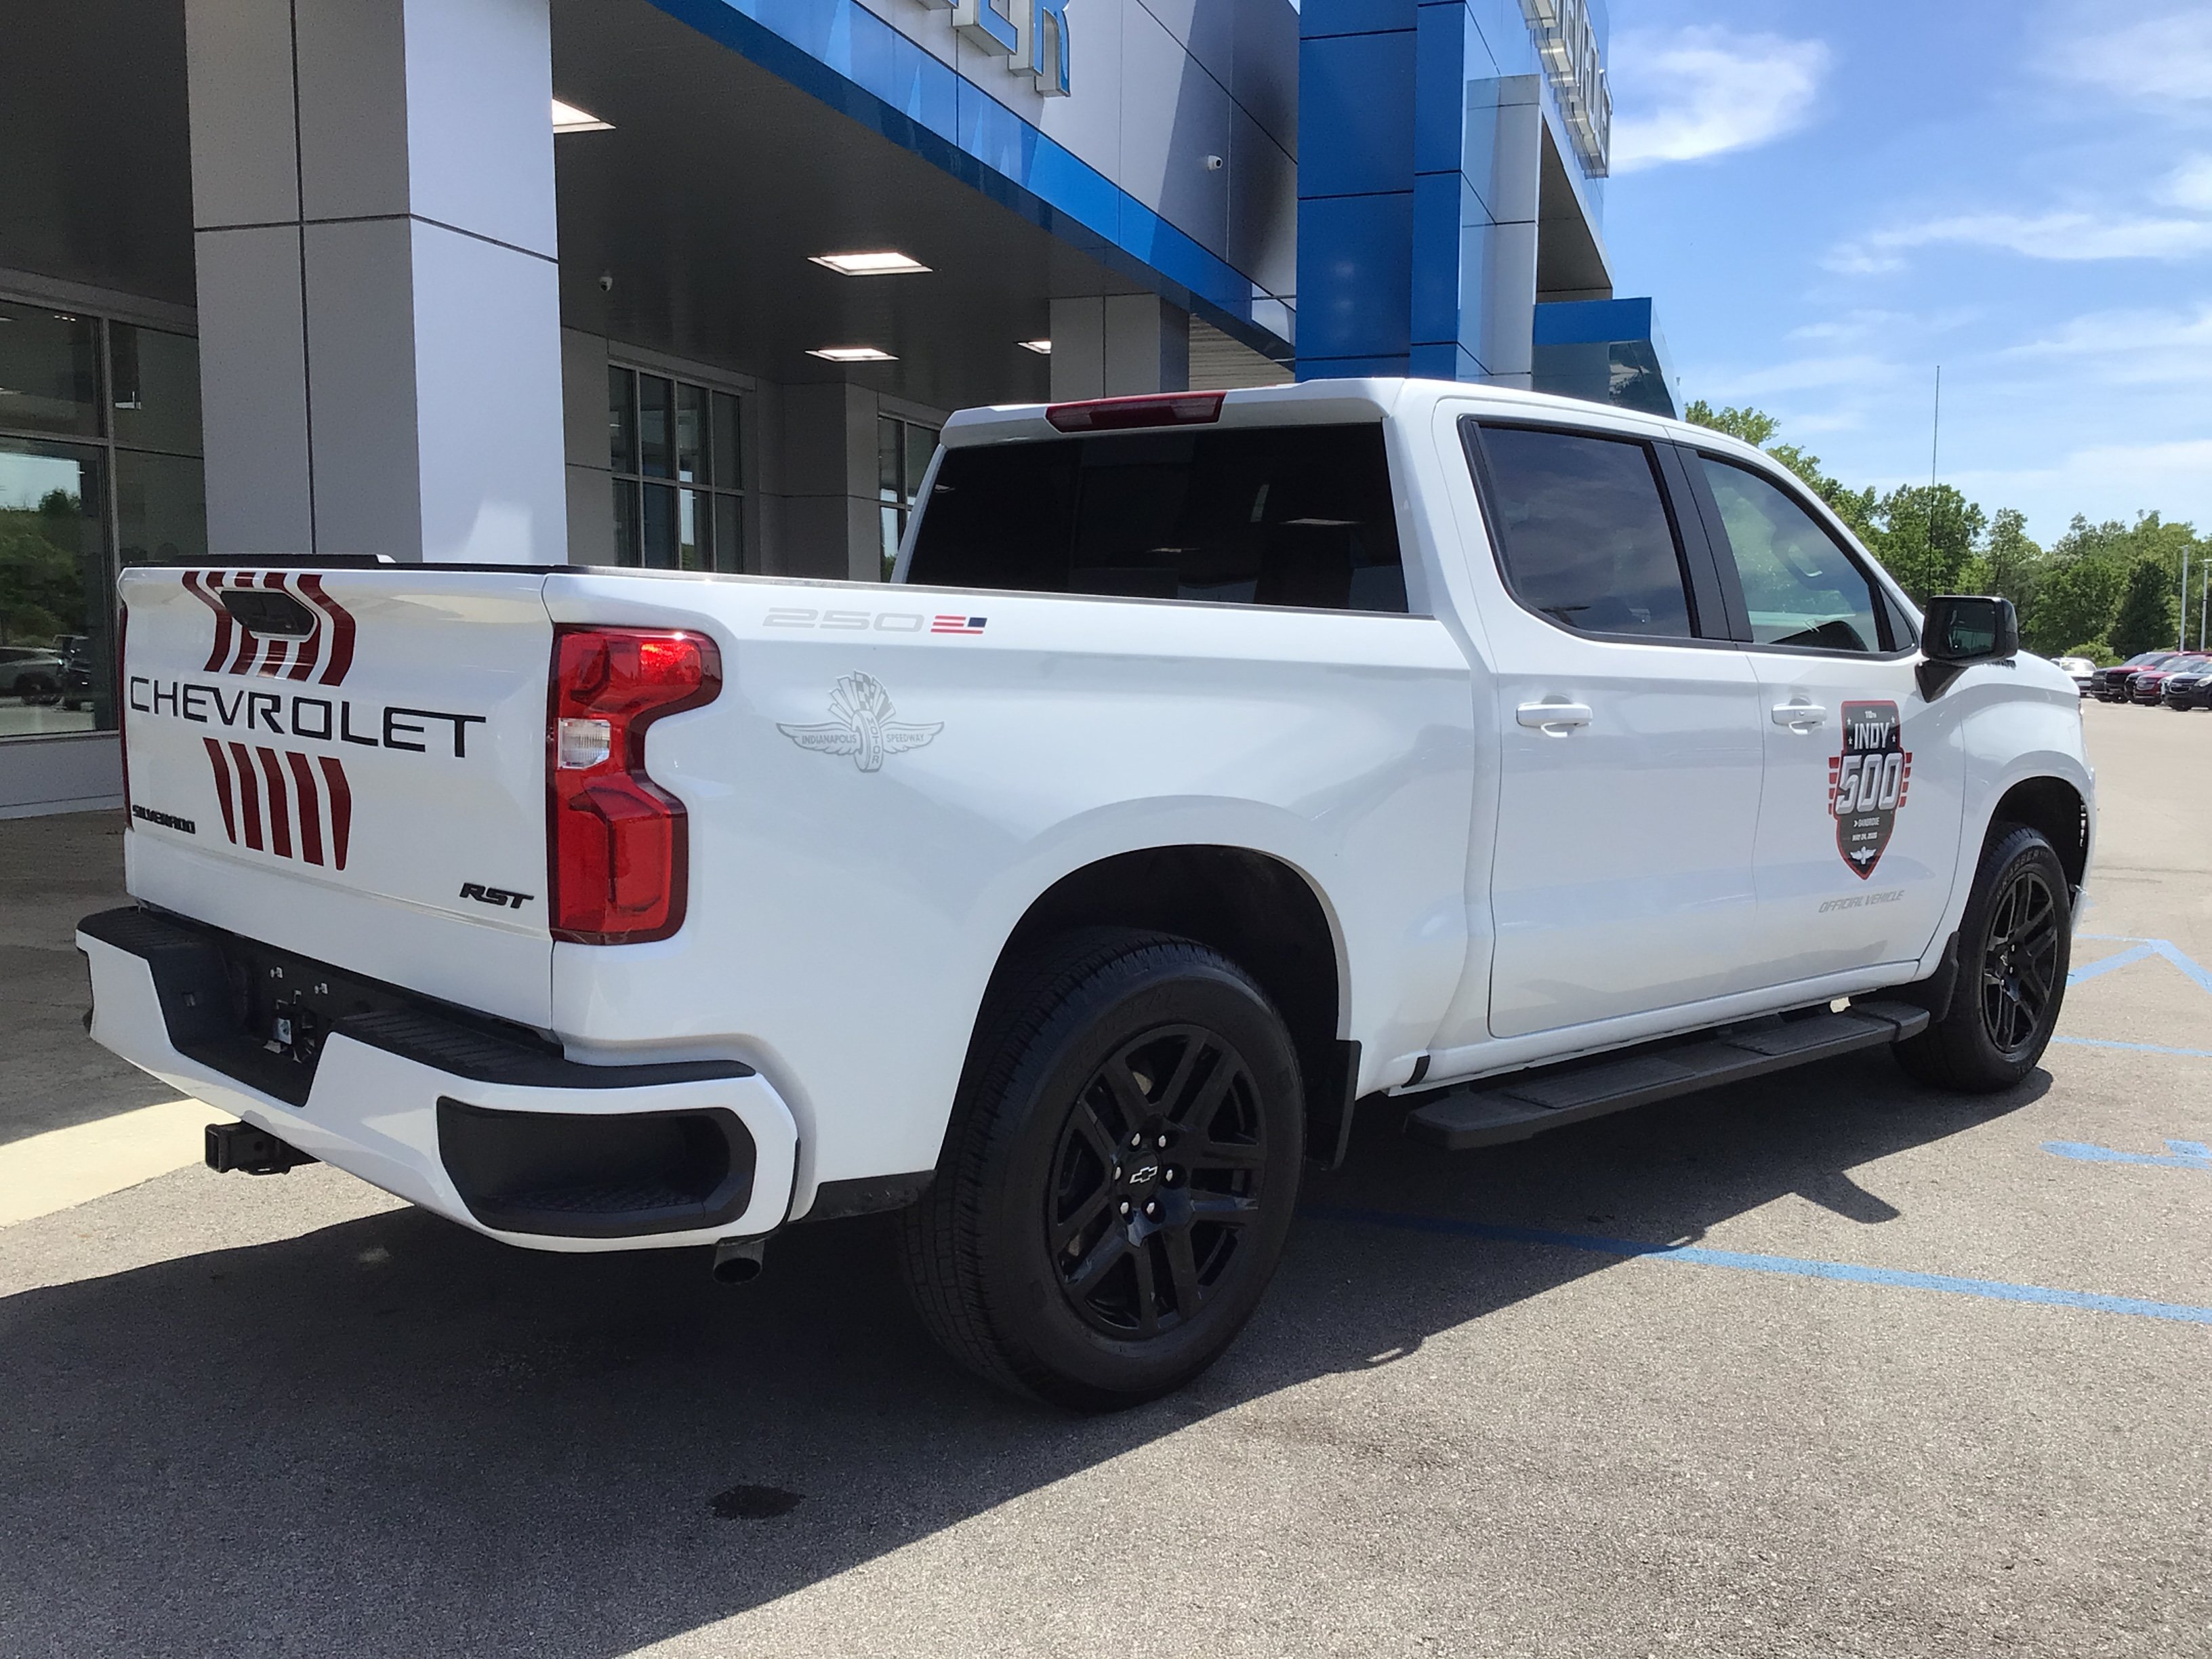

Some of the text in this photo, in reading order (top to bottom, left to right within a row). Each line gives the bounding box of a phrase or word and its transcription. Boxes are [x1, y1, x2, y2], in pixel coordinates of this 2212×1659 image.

[762, 607, 925, 633] 250
[129, 676, 487, 758] CHEVROLET
[802, 733, 857, 745] INDIANAPOLIS
[867, 716, 881, 764] MOTOR
[886, 733, 924, 743] SPEEDWAY
[1854, 722, 1891, 750] INDY
[1835, 753, 1903, 815] 500
[132, 804, 196, 834] SILVERADO
[459, 882, 535, 909] RST
[1818, 890, 1905, 914] OFFICIAL VEHICLE
